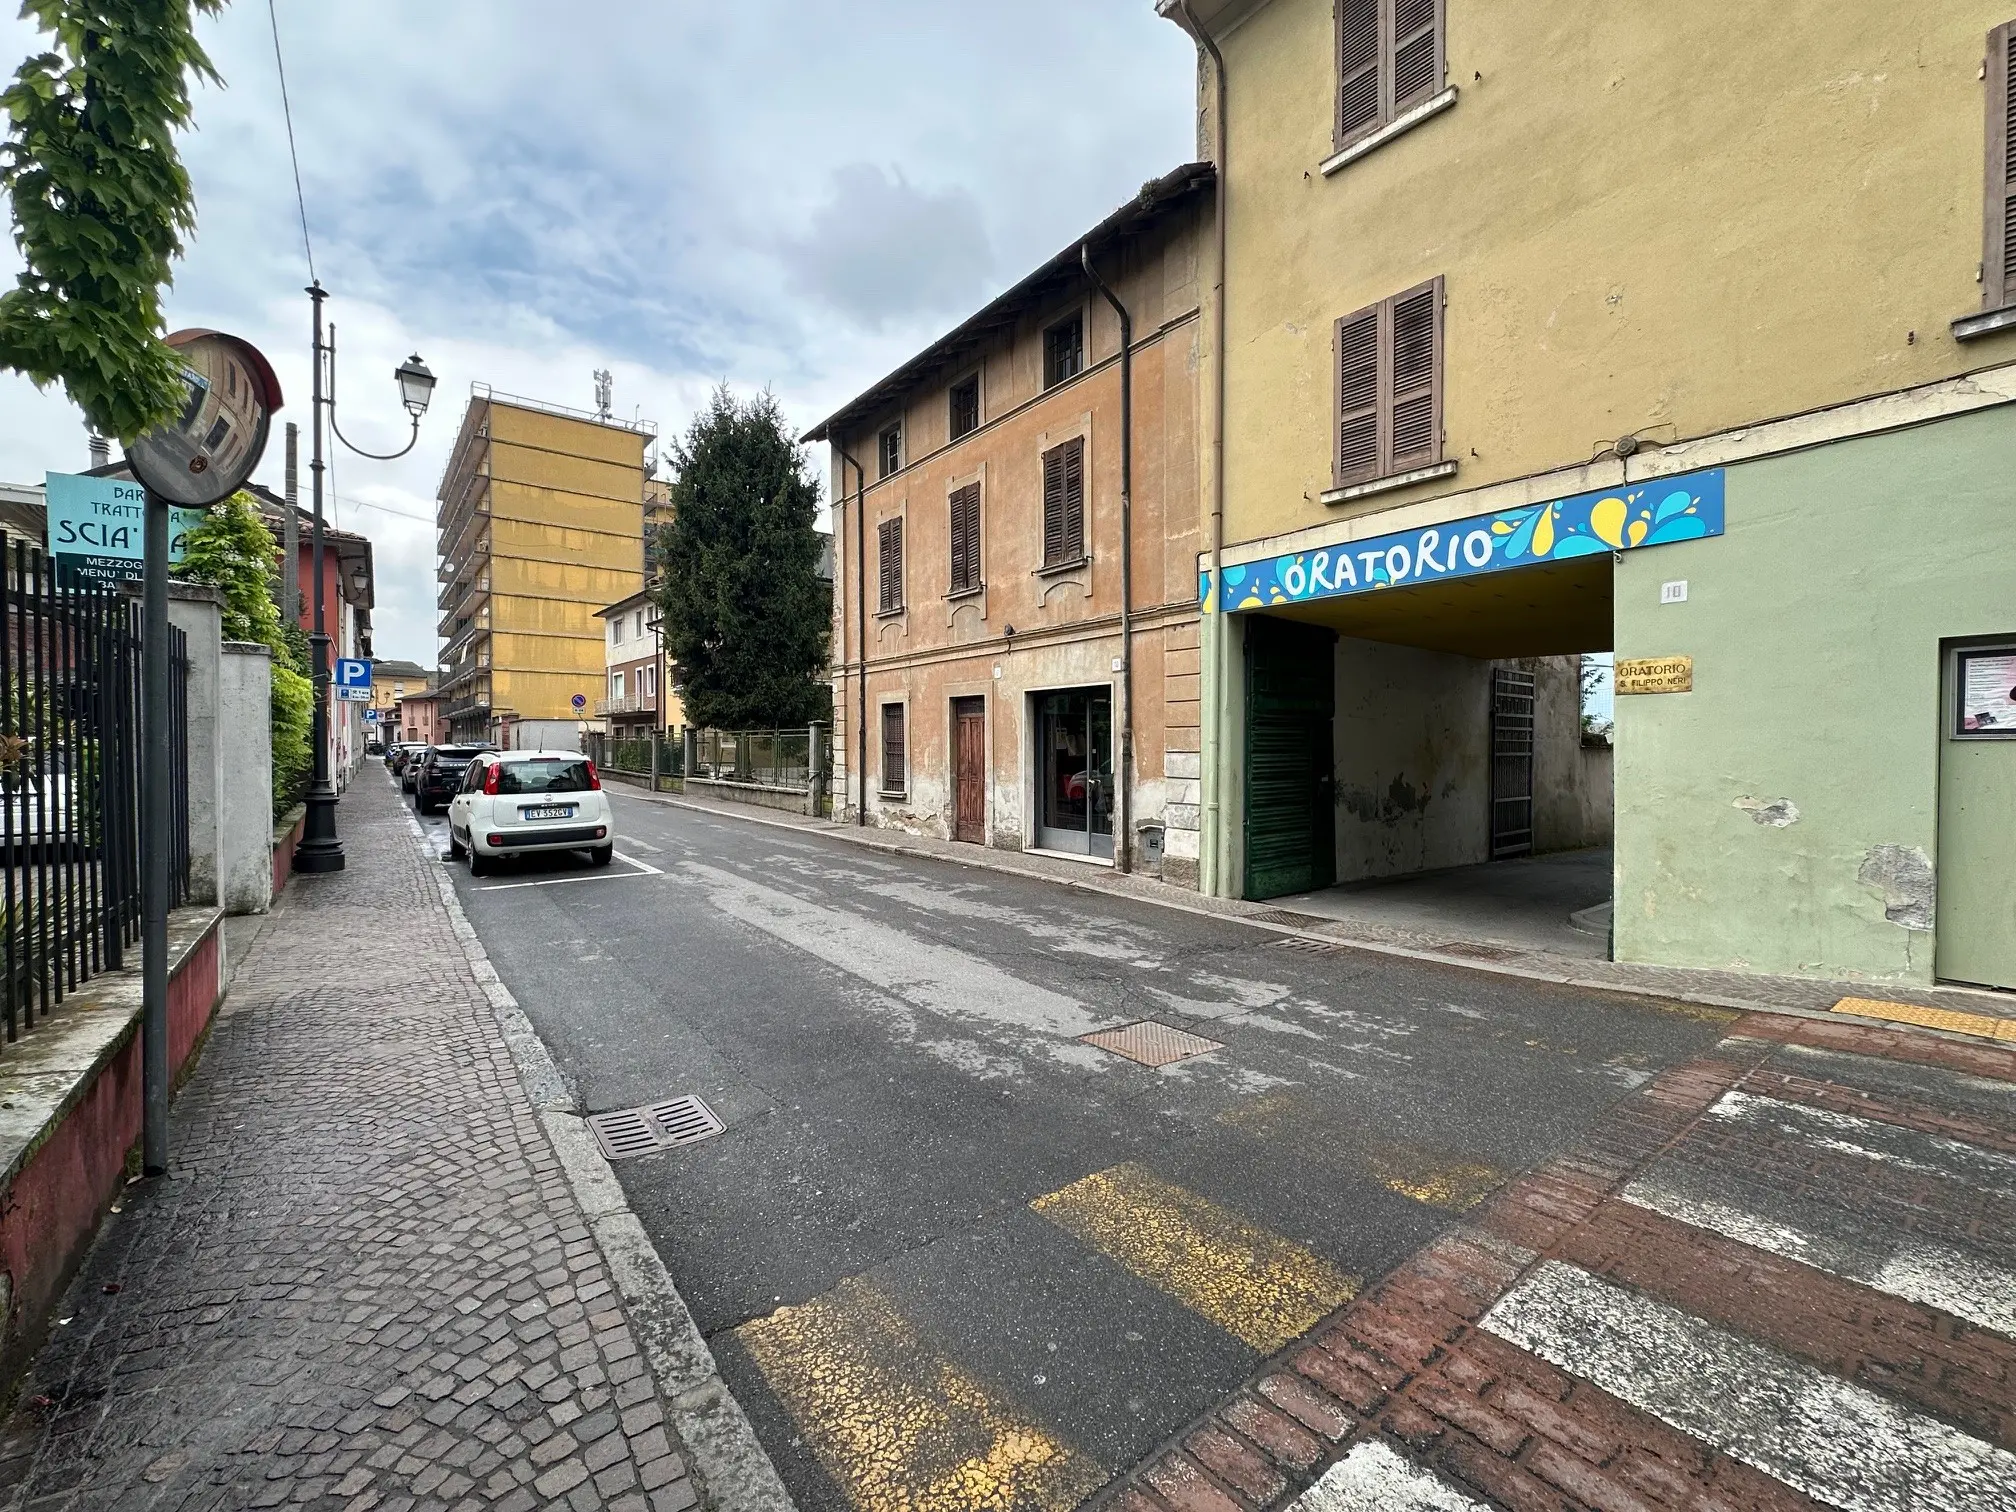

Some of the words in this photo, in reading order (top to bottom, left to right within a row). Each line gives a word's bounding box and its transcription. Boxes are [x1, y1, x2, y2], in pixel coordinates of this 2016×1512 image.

[113, 487, 144, 501] BAR
[1285, 530, 1493, 596] ORATORIO
[1666, 585, 1681, 599] 10
[343, 661, 365, 684] P
[1620, 664, 1686, 677] ORATORIO
[1632, 678, 1663, 687] FILIPPO
[1667, 677, 1686, 685] NERI
[366, 710, 375, 719] P
[531, 809, 540, 818] EV
